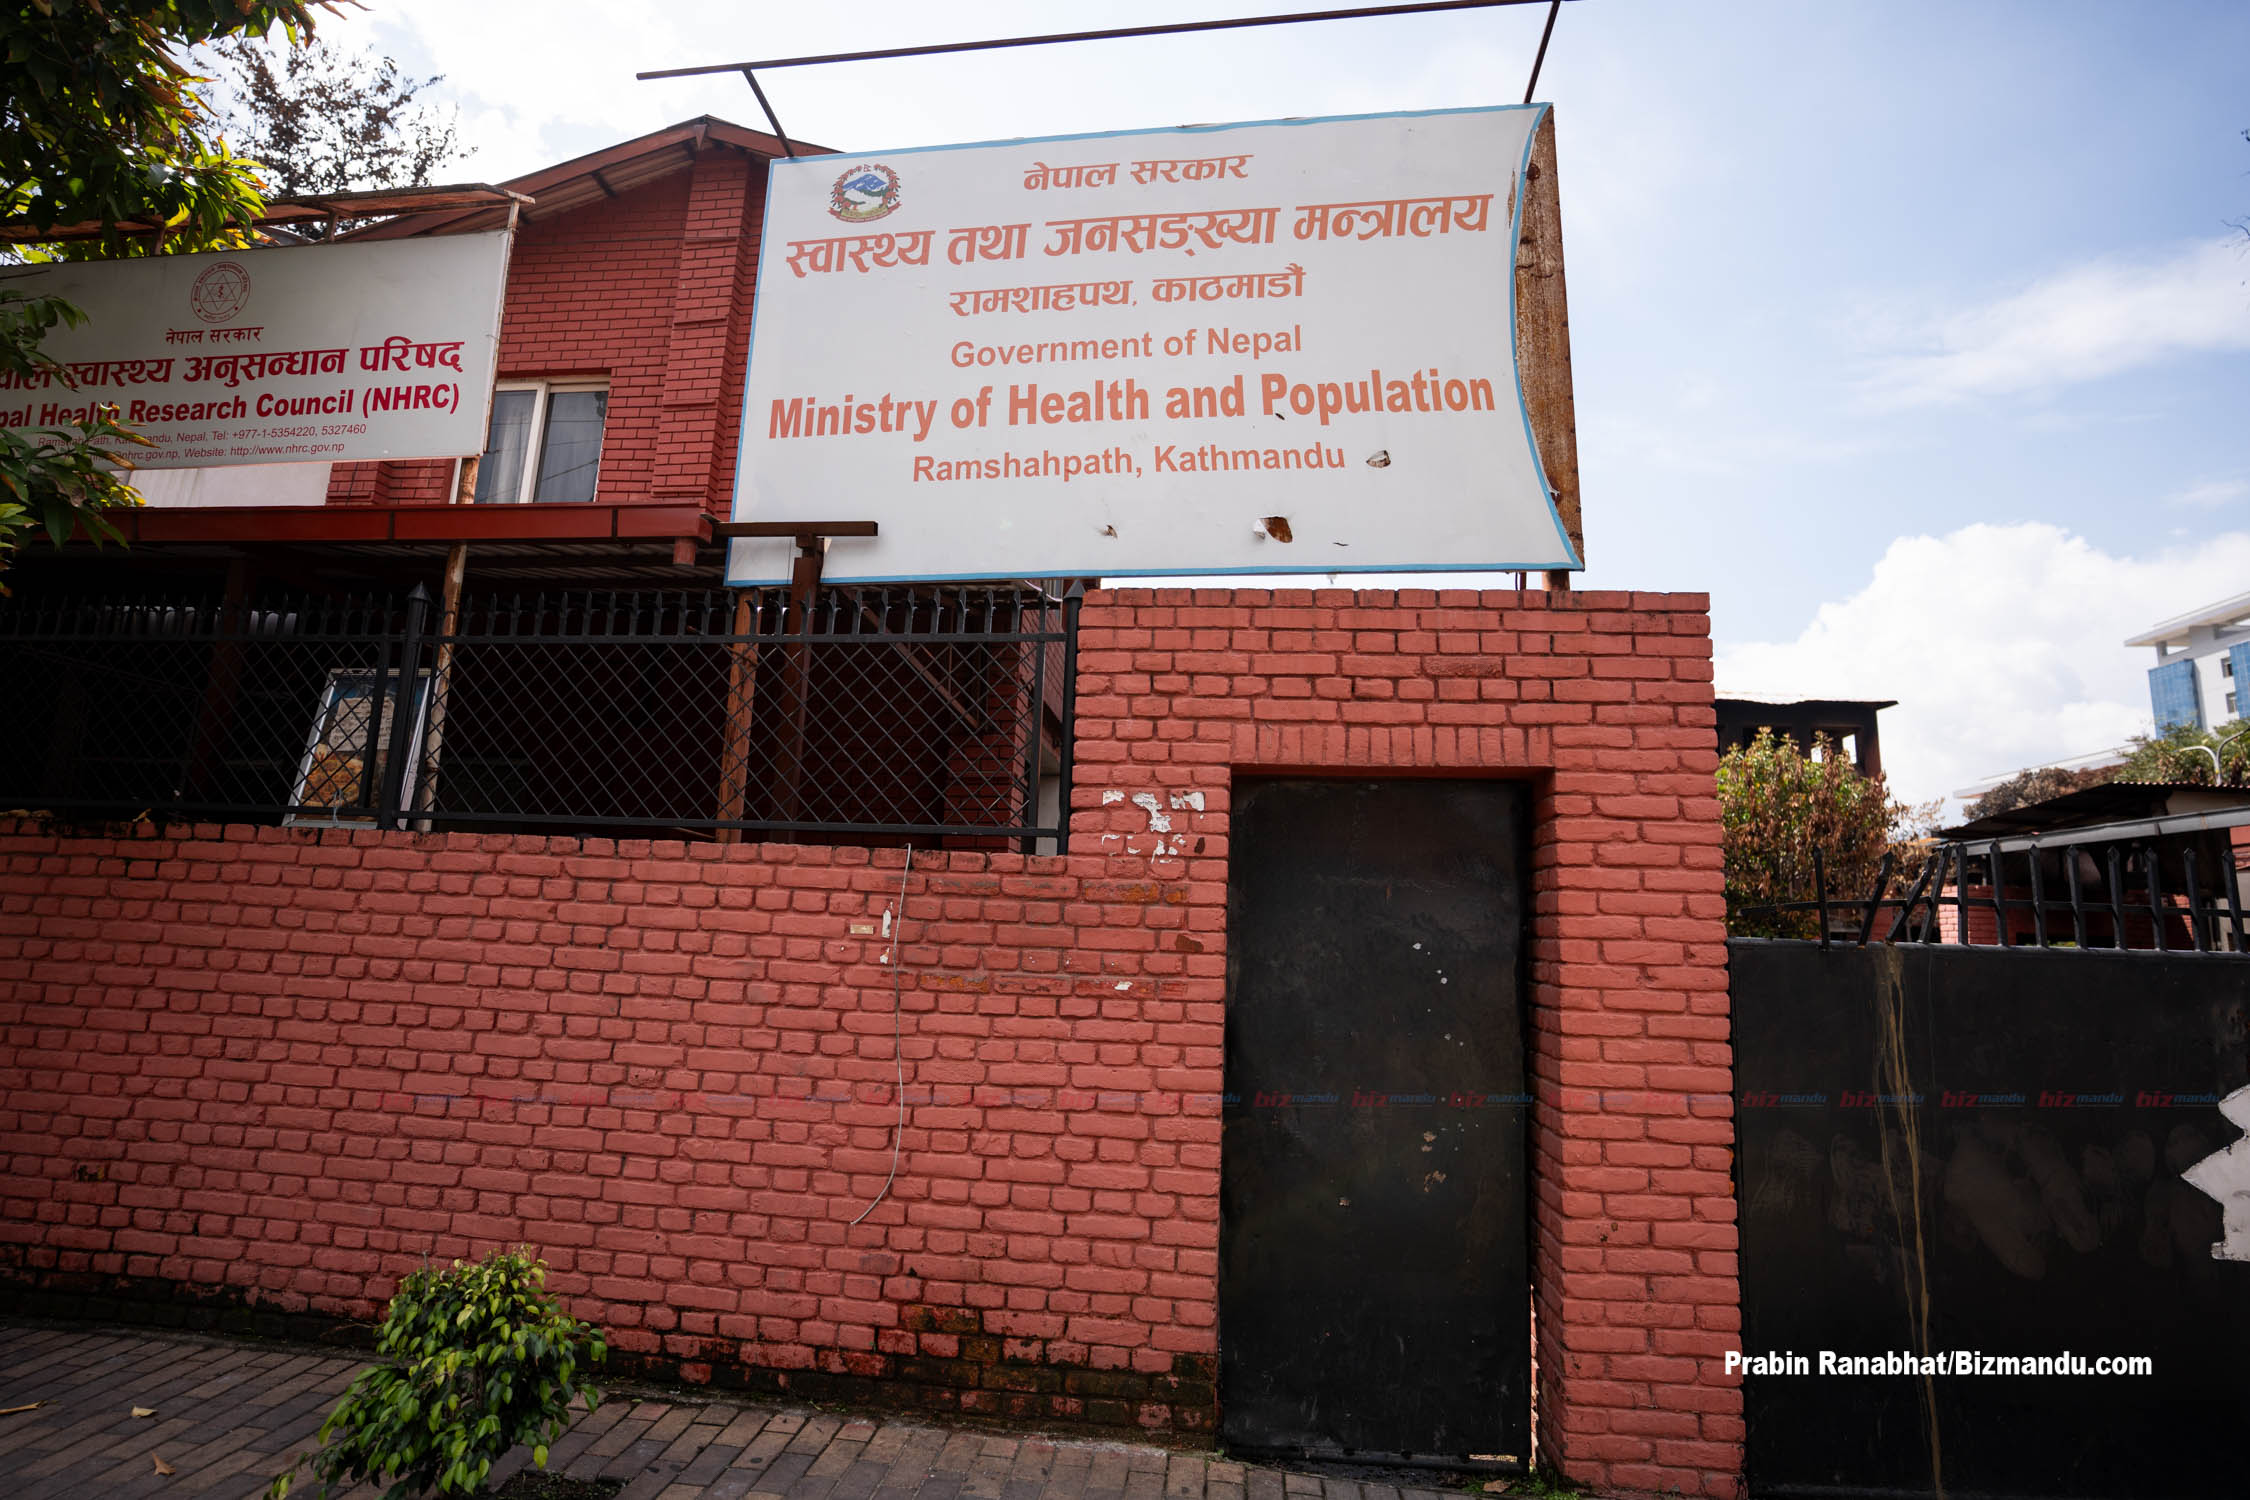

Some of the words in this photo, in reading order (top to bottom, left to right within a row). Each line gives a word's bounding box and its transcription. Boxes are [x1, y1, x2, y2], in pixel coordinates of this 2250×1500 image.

[1024, 162, 1121, 191] नेपाल
[1130, 154, 1254, 185] सरकार
[786, 229, 936, 279] स्वास्थ्य
[948, 222, 1031, 266] तथा
[1293, 193, 1495, 242] मन्त्रालय
[165, 328, 205, 345] नेपाल
[209, 326, 265, 343] सरकार
[951, 331, 1153, 369] Government
[1163, 330, 1198, 357] of
[1207, 324, 1303, 361] Nepal
[183, 348, 350, 388] अनुसन्धान
[359, 335, 465, 374] परिषद्
[128, 395, 247, 422] Research
[256, 388, 355, 418] Council
[361, 383, 461, 420] (NHRC)
[767, 396, 938, 442] Ministry
[951, 386, 993, 429] of
[1007, 378, 1150, 426] Health
[1164, 373, 1246, 420] and
[1260, 368, 1497, 427] Population
[184, 446, 227, 458] Website:
[212, 430, 228, 441] Tel:
[321, 423, 367, 436] 5327460
[912, 447, 1143, 484] Ramshahpath,
[1153, 440, 1345, 473] Kathmandu
